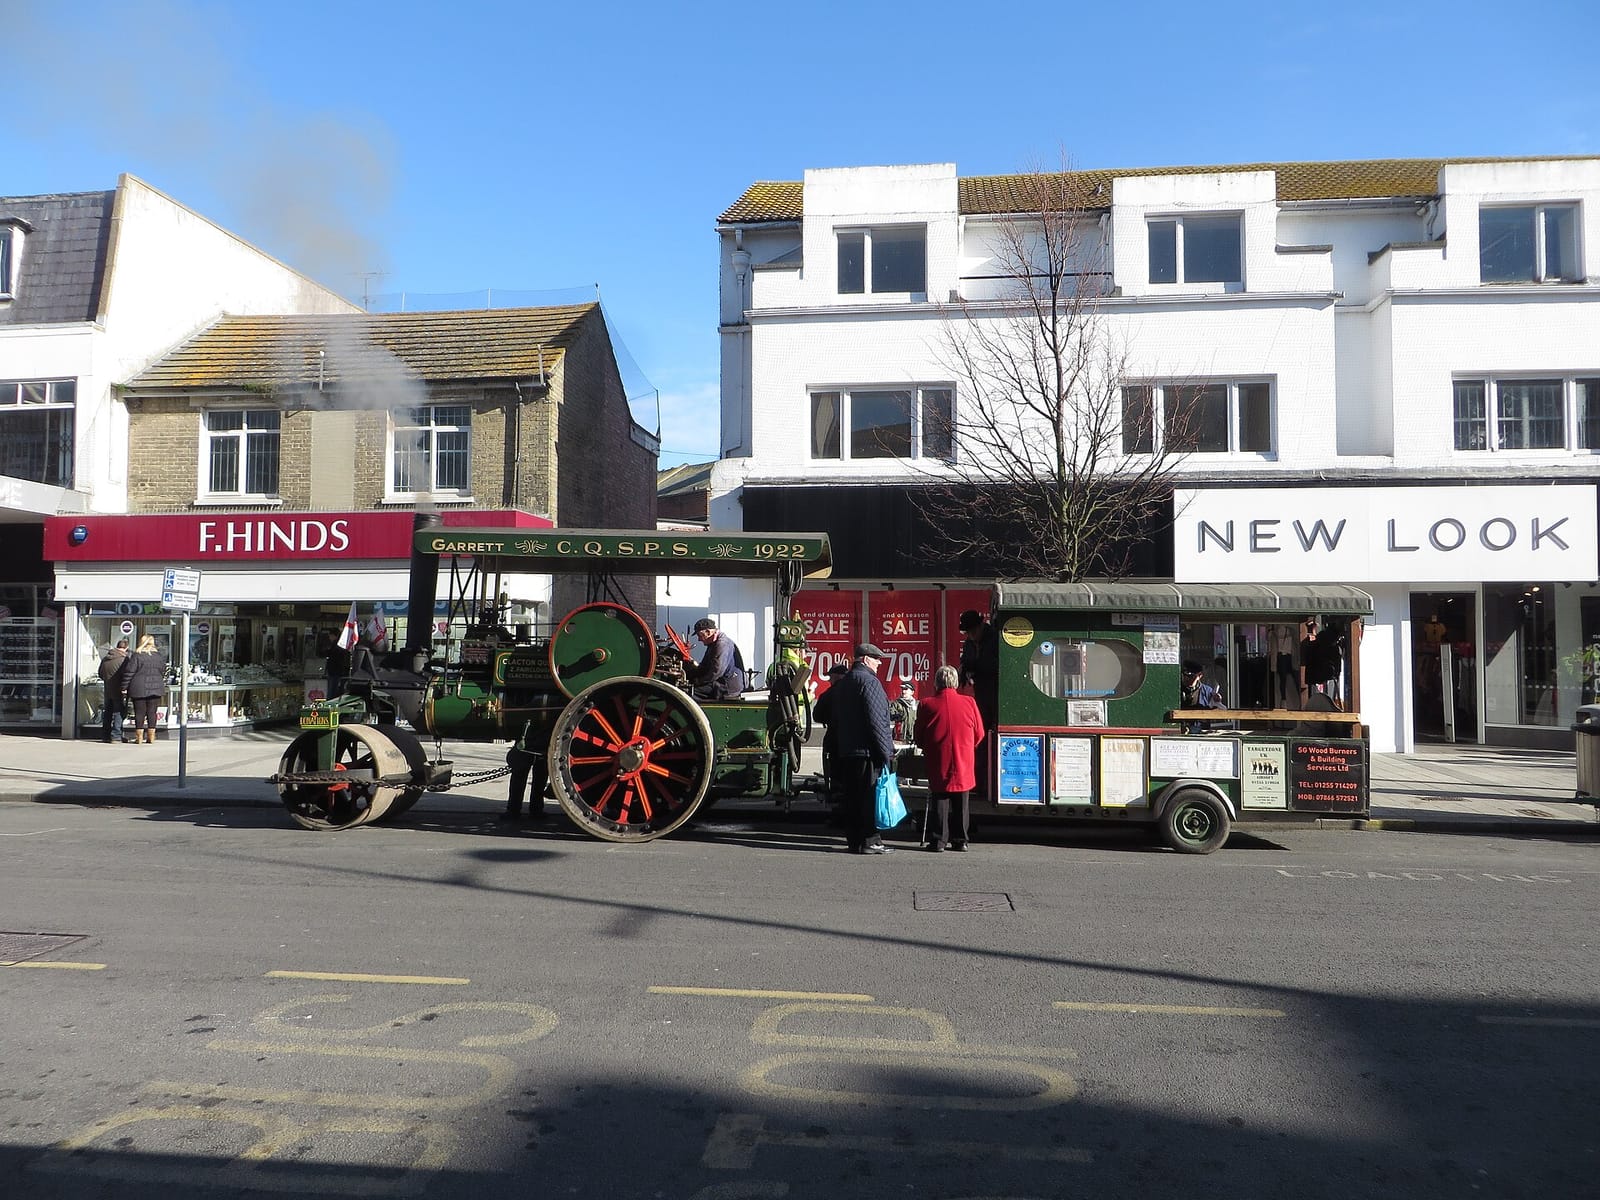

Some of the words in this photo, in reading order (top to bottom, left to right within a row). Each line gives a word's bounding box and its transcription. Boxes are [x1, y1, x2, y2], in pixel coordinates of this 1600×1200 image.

[198, 520, 350, 552] F.HINDS
[1197, 518, 1346, 554] NEW
[1387, 517, 1570, 553] LOOK
[431, 538, 504, 553] GARRETT
[753, 543, 806, 559] 1922
[805, 620, 850, 635] SALE
[882, 620, 929, 635] SALE
[914, 671, 930, 681] OFF
[1329, 747, 1358, 755] Burners
[1317, 756, 1346, 764] Building
[1275, 868, 1572, 883] LOADING
